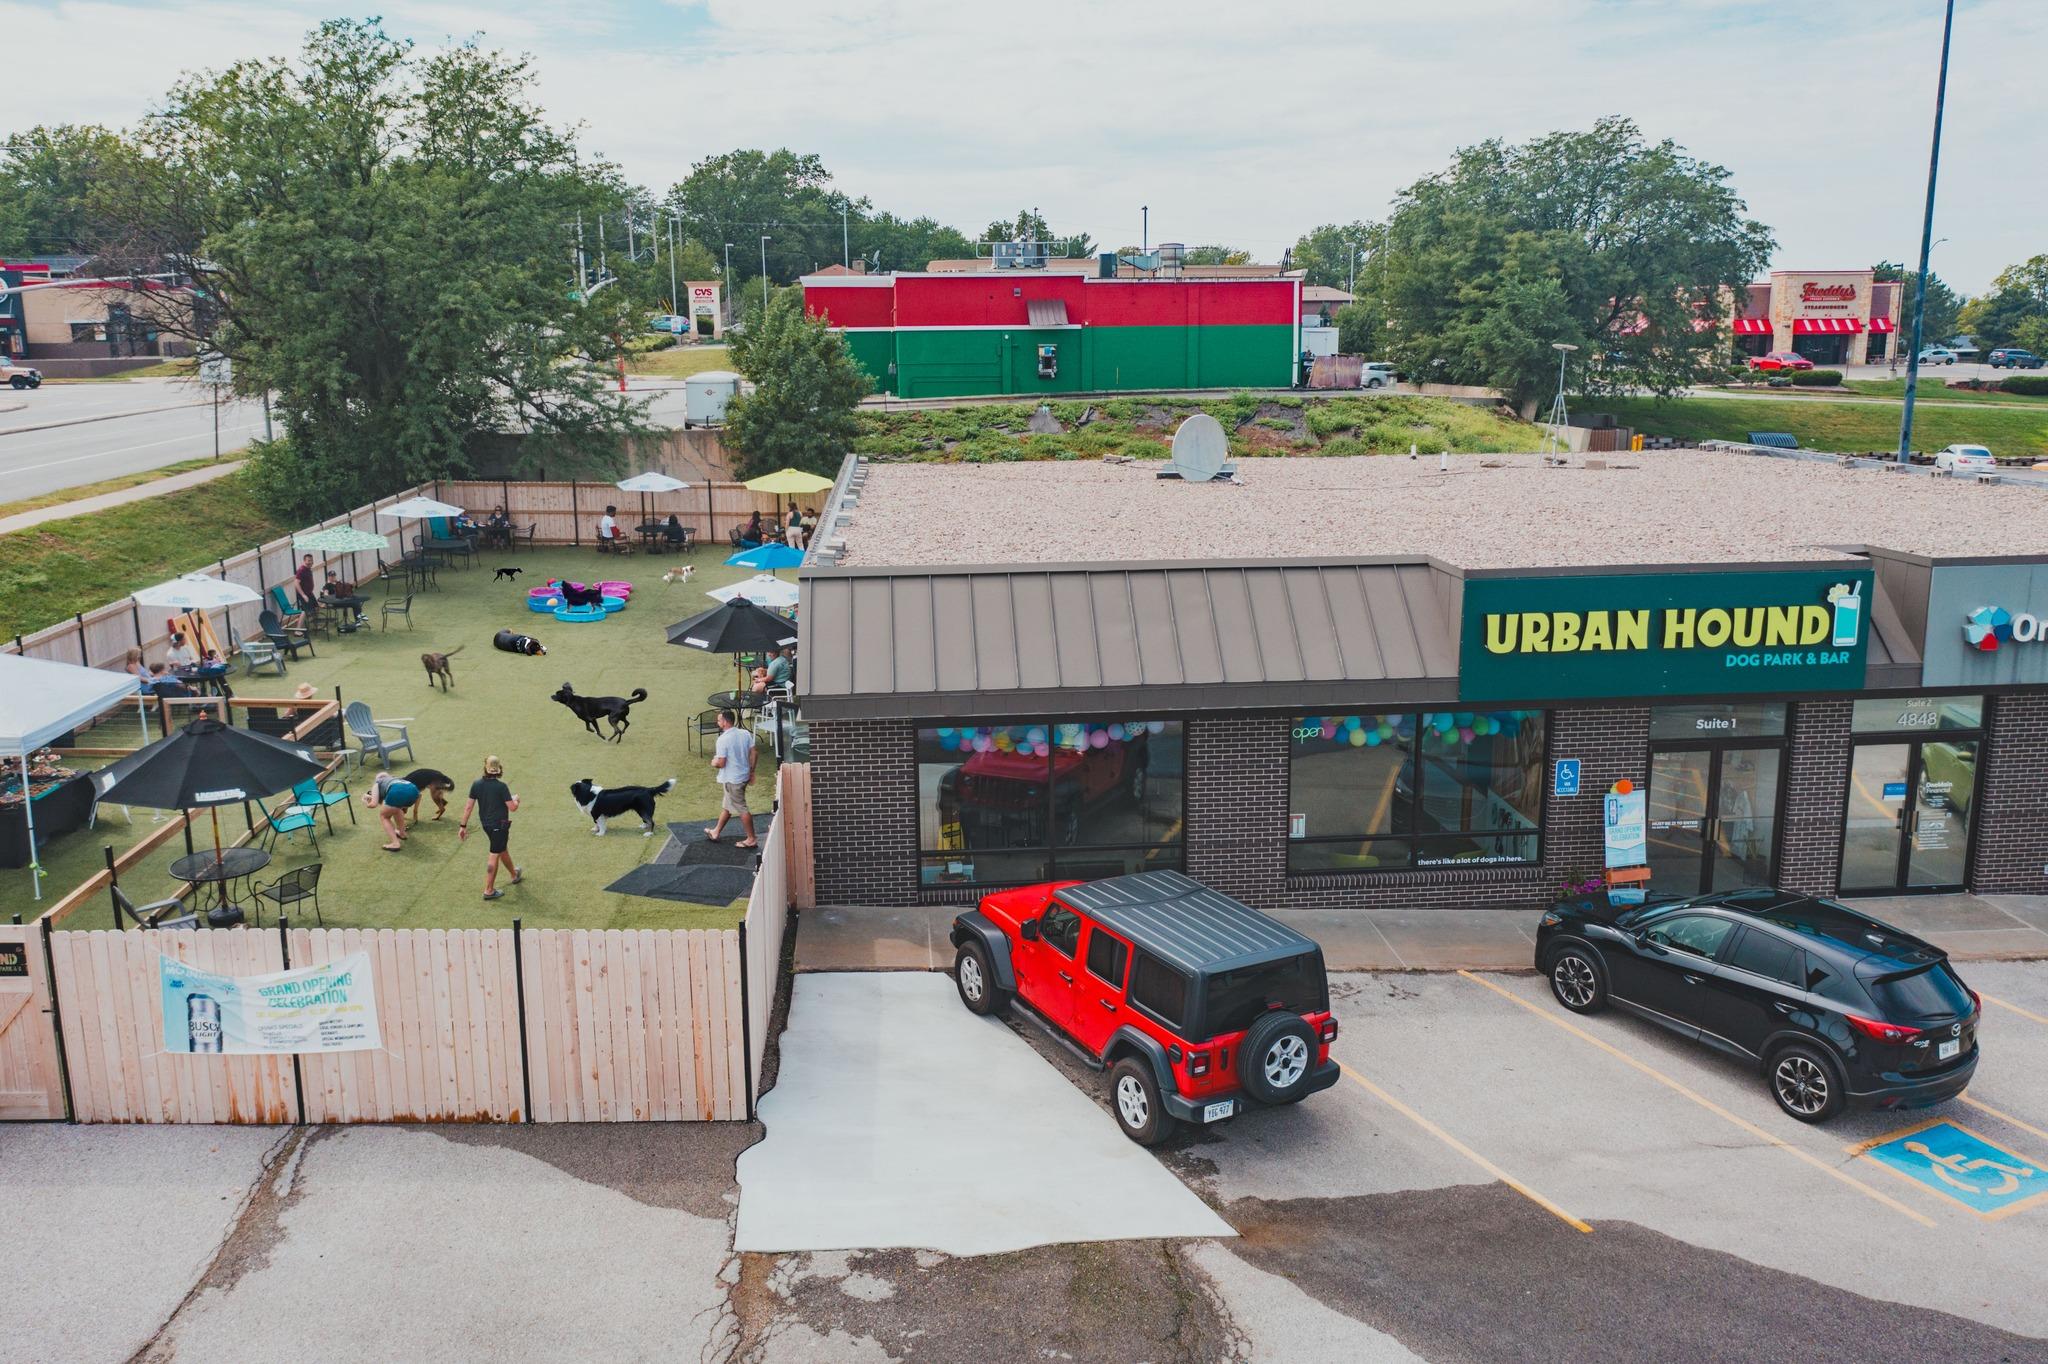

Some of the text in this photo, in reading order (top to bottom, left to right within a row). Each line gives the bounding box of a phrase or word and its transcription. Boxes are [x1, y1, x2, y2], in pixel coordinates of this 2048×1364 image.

[694, 288, 713, 296] CVS
[1486, 604, 1829, 654] URBAN HOUND
[1726, 651, 1850, 667] DOG PARK & BAR
[1696, 718, 1737, 729] Suite 1
[1898, 711, 1937, 727] 4848
[1292, 727, 1325, 744] open
[258, 972, 353, 997] GRAND OPENING
[267, 989, 348, 1008] CELEBRATION
